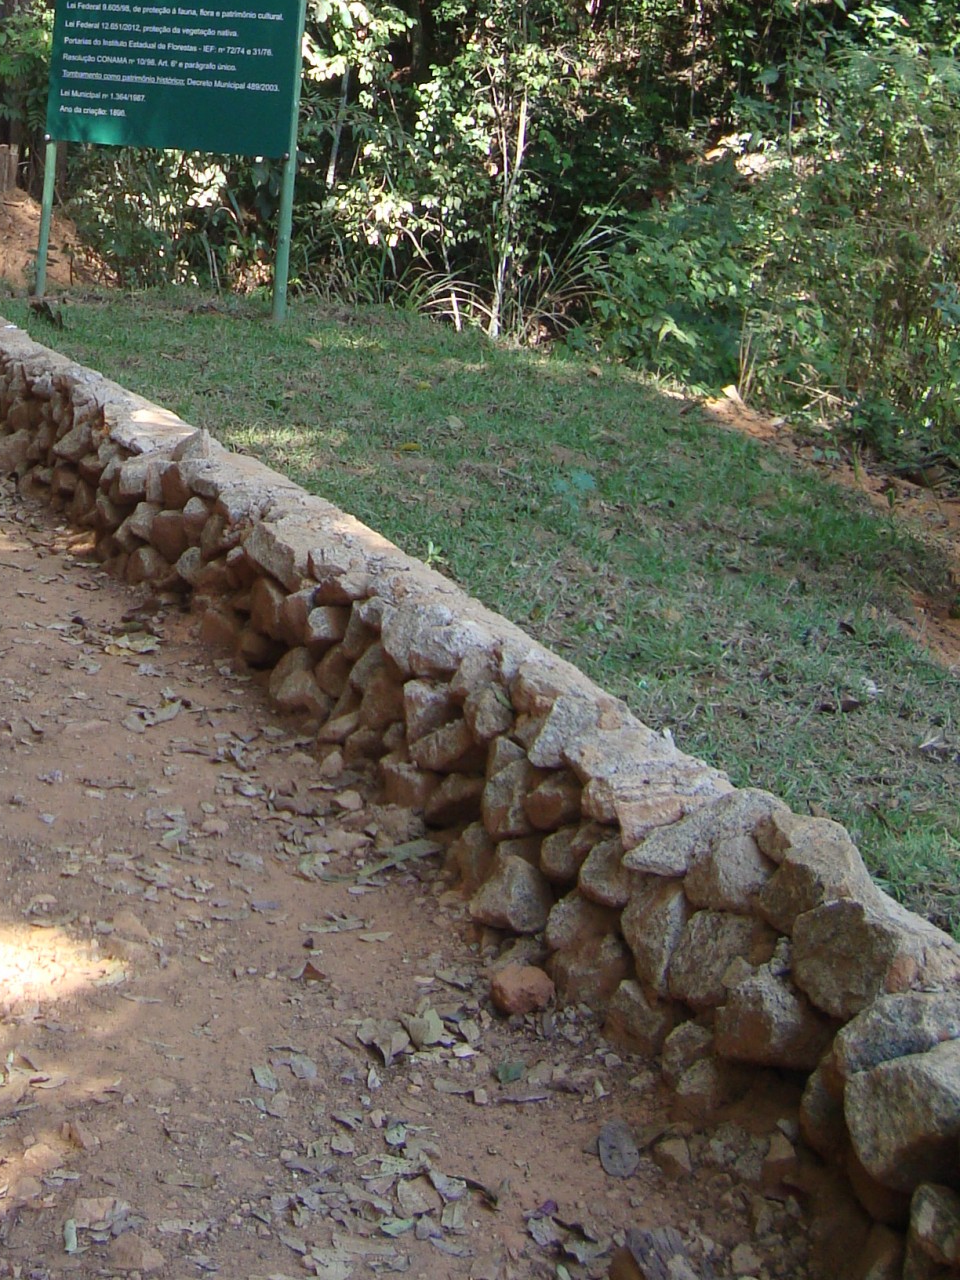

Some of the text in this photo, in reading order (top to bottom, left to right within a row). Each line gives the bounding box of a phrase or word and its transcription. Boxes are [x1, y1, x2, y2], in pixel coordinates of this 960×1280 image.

[66, 1, 76, 9] Lei
[77, 2, 102, 10] Federal
[142, 7, 171, 15] proteção
[65, 20, 75, 28] Lei
[76, 21, 100, 29] Federal
[143, 25, 172, 34] proteção
[182, 27, 216, 37] vegetação
[64, 37, 92, 45] Portarias
[102, 39, 127, 47] Instituto
[128, 40, 157, 49] Estadual
[167, 43, 197, 52] Florestas
[226, 46, 245, 55] 72/74
[63, 53, 95, 63] Resolução
[96, 55, 127, 64] CONAMA
[186, 78, 213, 87] Decreto
[213, 81, 245, 90] Municipal
[60, 89, 70, 97] Lei
[71, 90, 101, 99] Municipal
